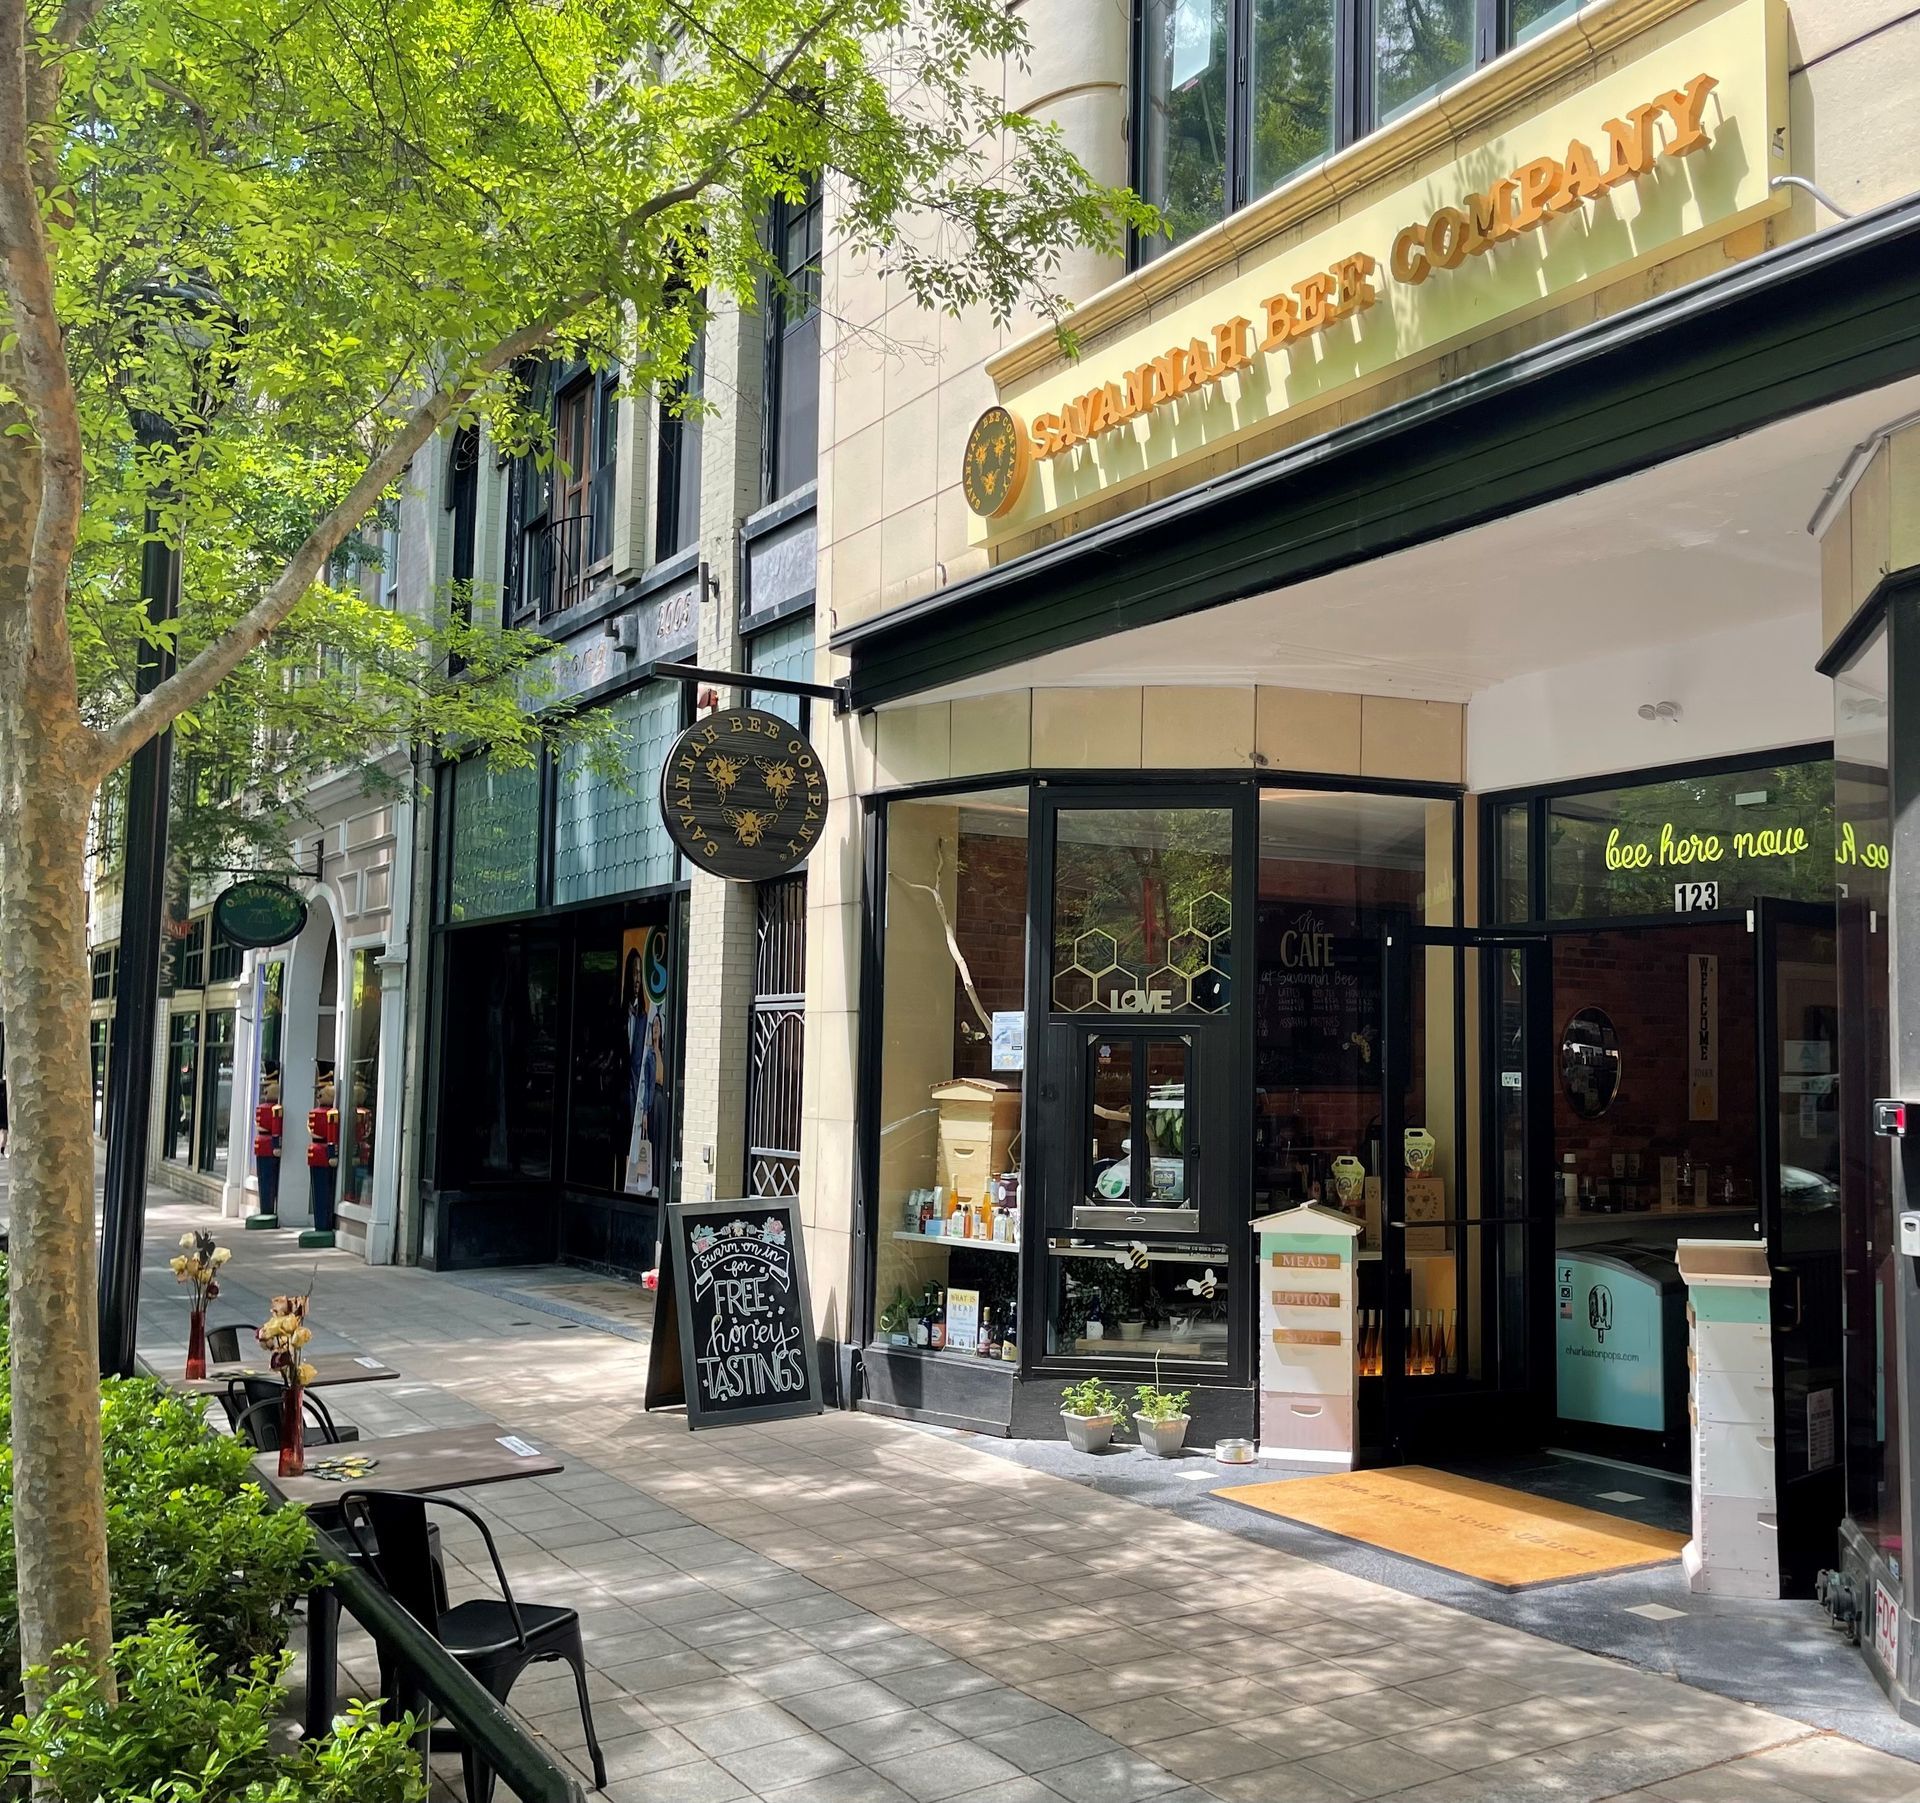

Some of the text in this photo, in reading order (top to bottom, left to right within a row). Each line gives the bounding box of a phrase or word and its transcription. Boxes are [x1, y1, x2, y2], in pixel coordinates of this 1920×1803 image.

[1030, 73, 1719, 459] SAVANNAH BEE COMPANY
[965, 411, 1016, 510] SAVANNAH BEE COMPANY
[675, 716, 822, 858] SAVANNAH BEE COMPANY
[1605, 823, 1809, 871] bee here now
[1677, 883, 1716, 911] 123
[1280, 930, 1335, 968] CAFE
[1278, 968, 1330, 986] Savannah
[1335, 971, 1358, 985] Bee
[1110, 989, 1173, 1013] LOVE
[1698, 957, 1710, 1061] WELCOME
[699, 1241, 784, 1270] swarm on in
[723, 1258, 756, 1278] for
[1282, 1254, 1328, 1267] MEAD
[713, 1273, 770, 1317] FREE
[1277, 1292, 1331, 1306] LOTION
[706, 1314, 800, 1358] honey
[1565, 1344, 1640, 1363] charlestonpops.com
[697, 1349, 805, 1400] TASTINGS
[1876, 1588, 1897, 1649] FDC
